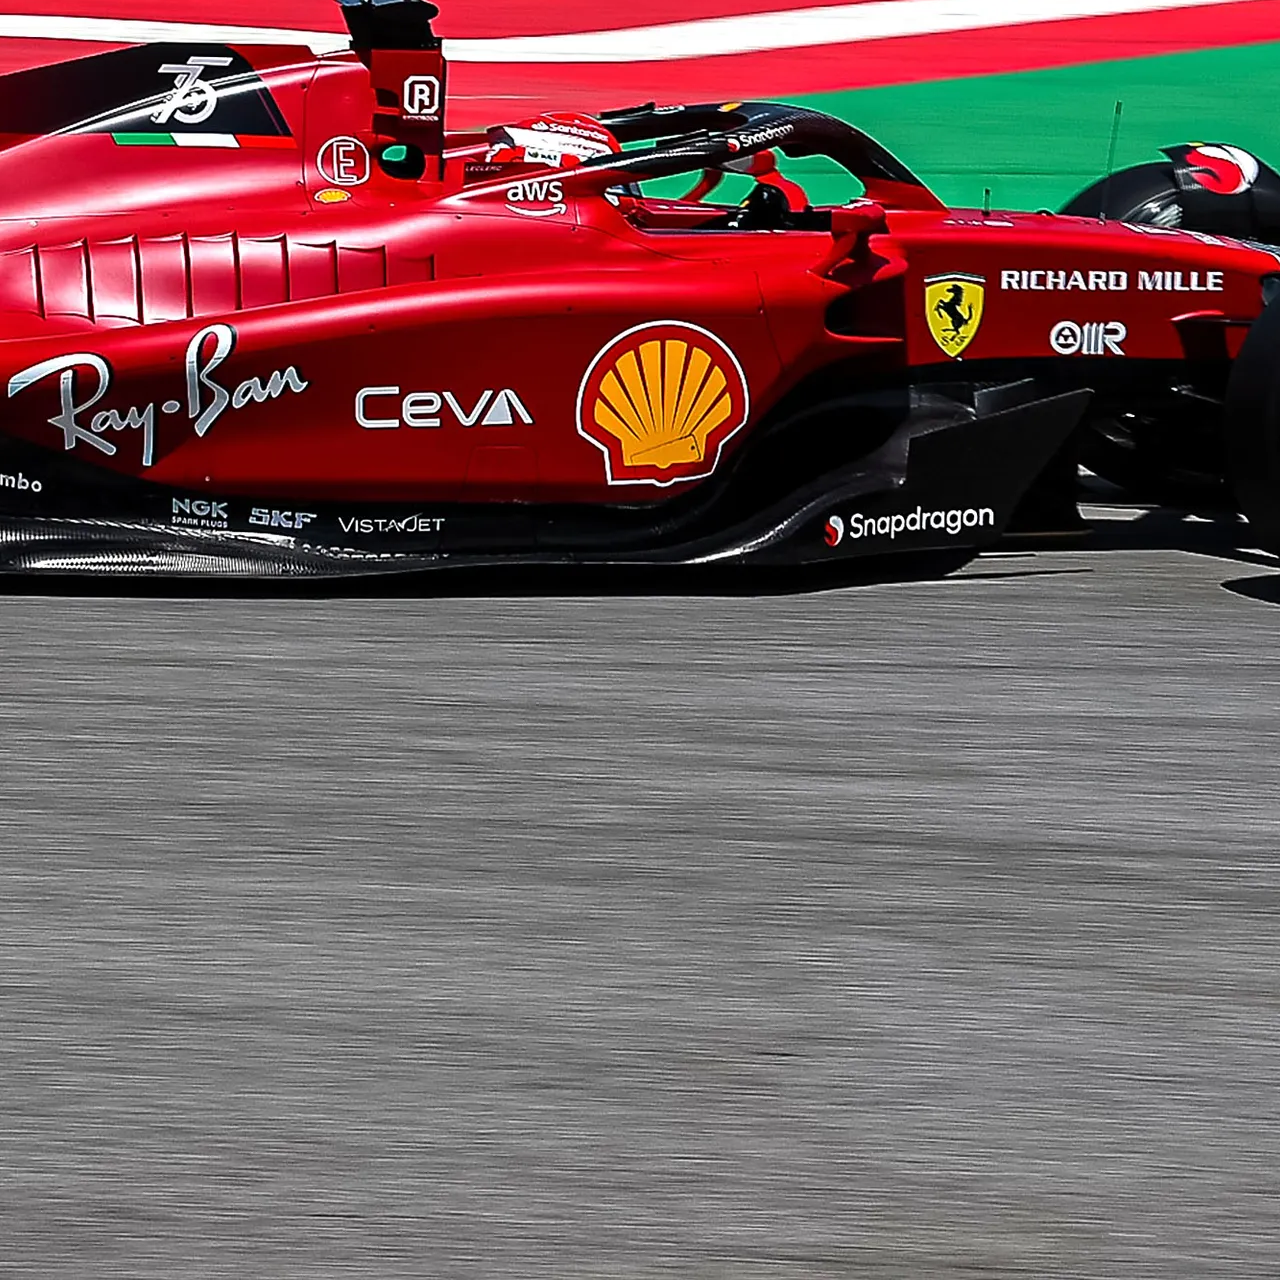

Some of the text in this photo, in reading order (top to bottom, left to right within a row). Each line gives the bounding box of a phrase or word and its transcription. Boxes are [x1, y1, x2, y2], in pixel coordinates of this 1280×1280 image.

[507, 181, 563, 202] aws
[1000, 270, 1224, 291] RICHARD MILLE
[8, 323, 309, 466] Ray-Ban
[172, 497, 228, 519] NGK
[249, 507, 318, 529] SKF
[172, 516, 228, 528] SPARK PLUGS
[850, 506, 994, 540] Snapdragon
